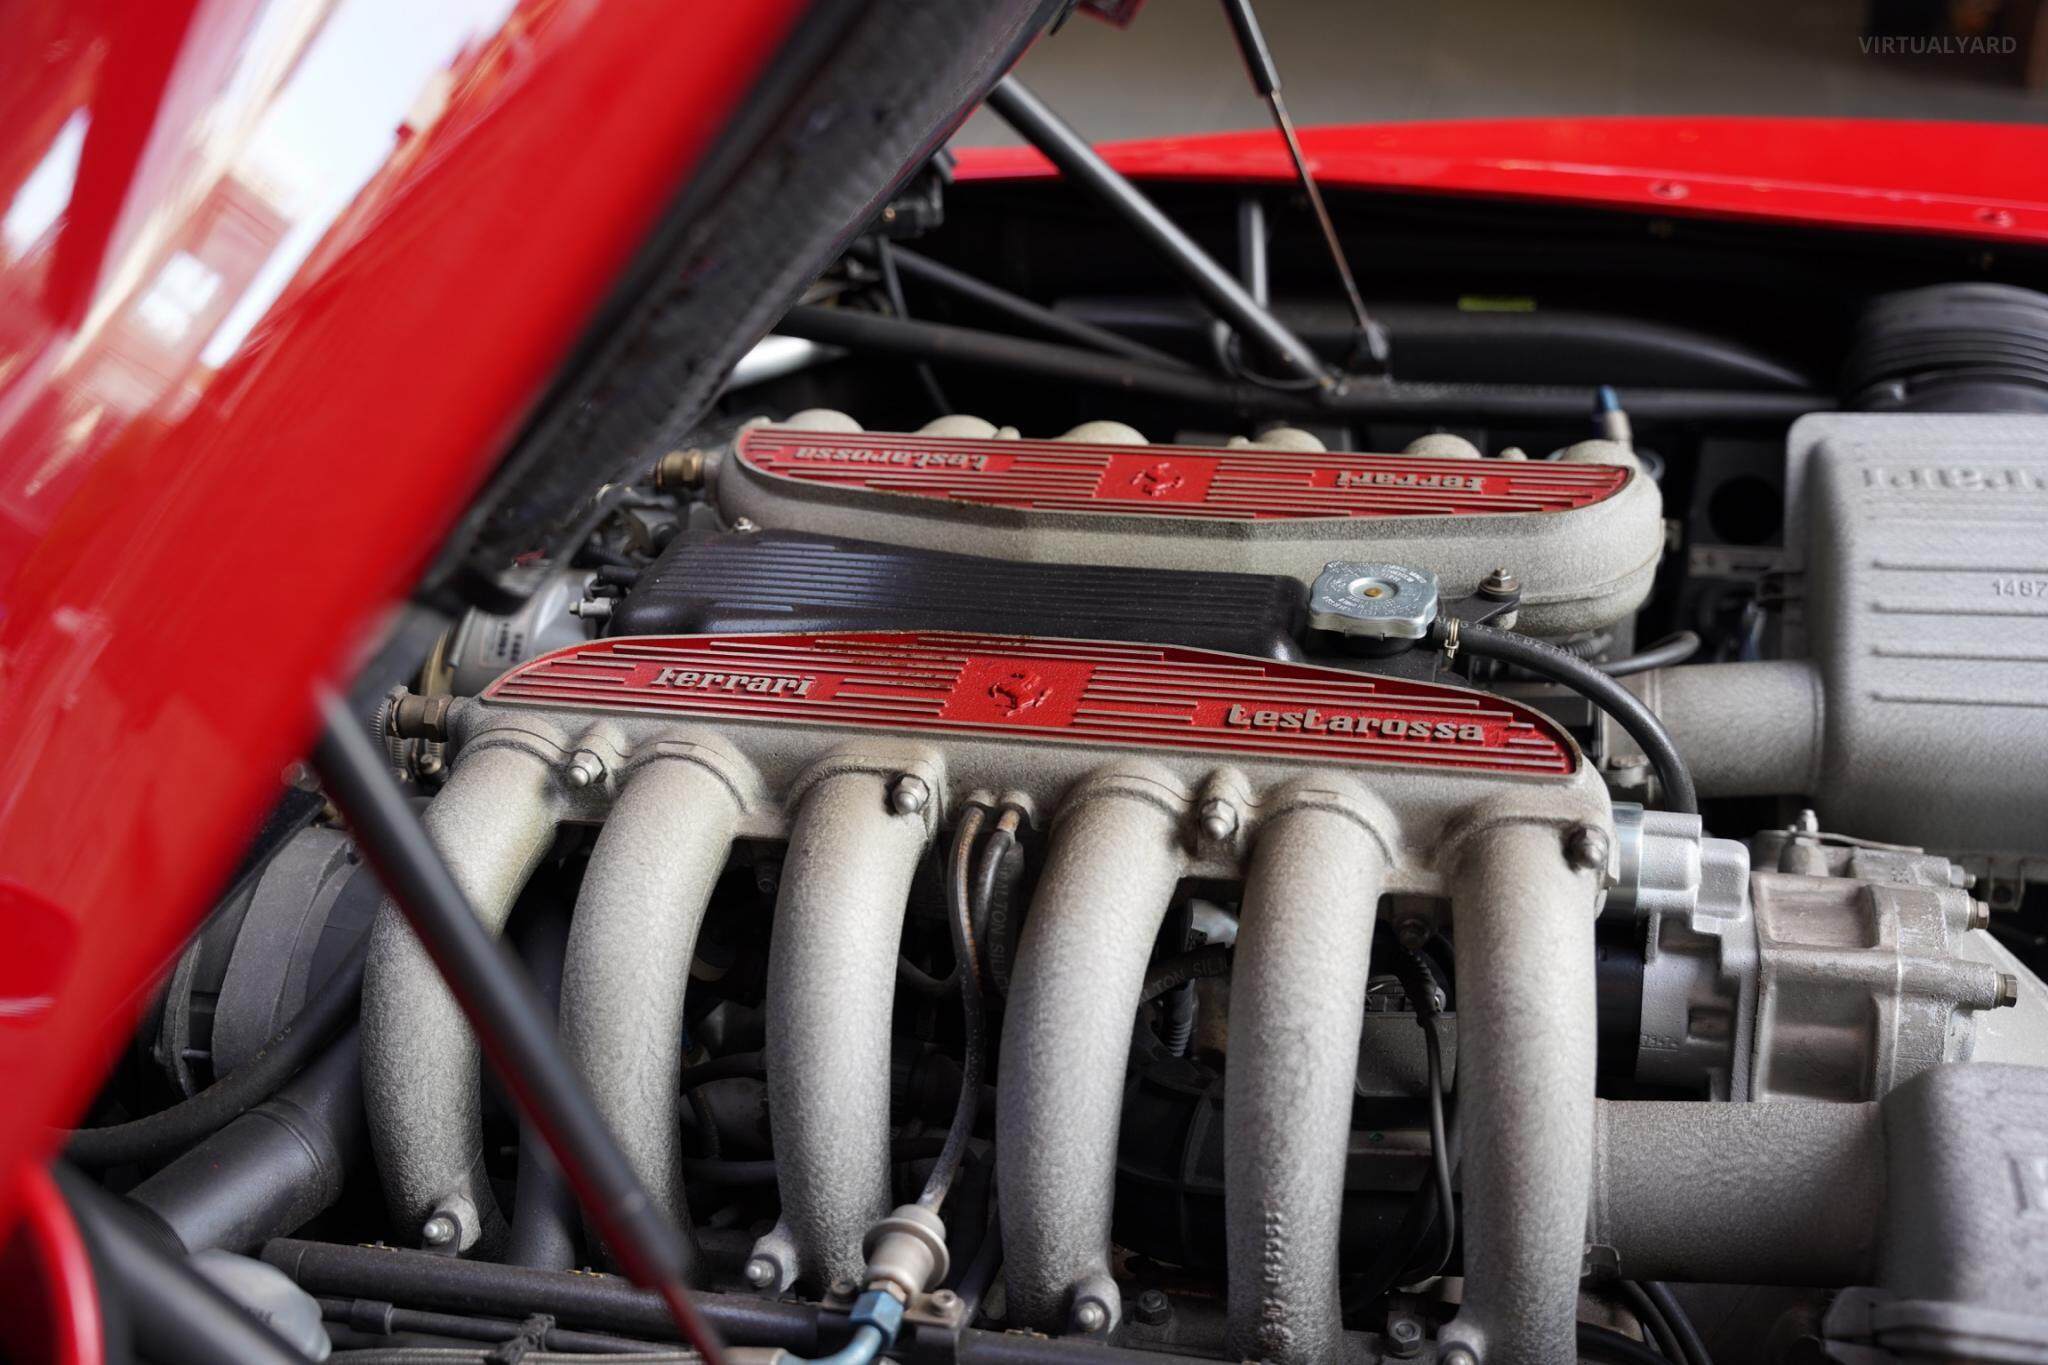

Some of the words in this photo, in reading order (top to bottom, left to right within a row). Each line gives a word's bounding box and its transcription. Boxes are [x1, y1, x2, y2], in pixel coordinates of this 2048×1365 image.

[796, 445, 989, 471] testarossa
[1337, 470, 1485, 492] Ferrari
[652, 667, 817, 697] Ferrari
[1227, 703, 1486, 744] testarossa
